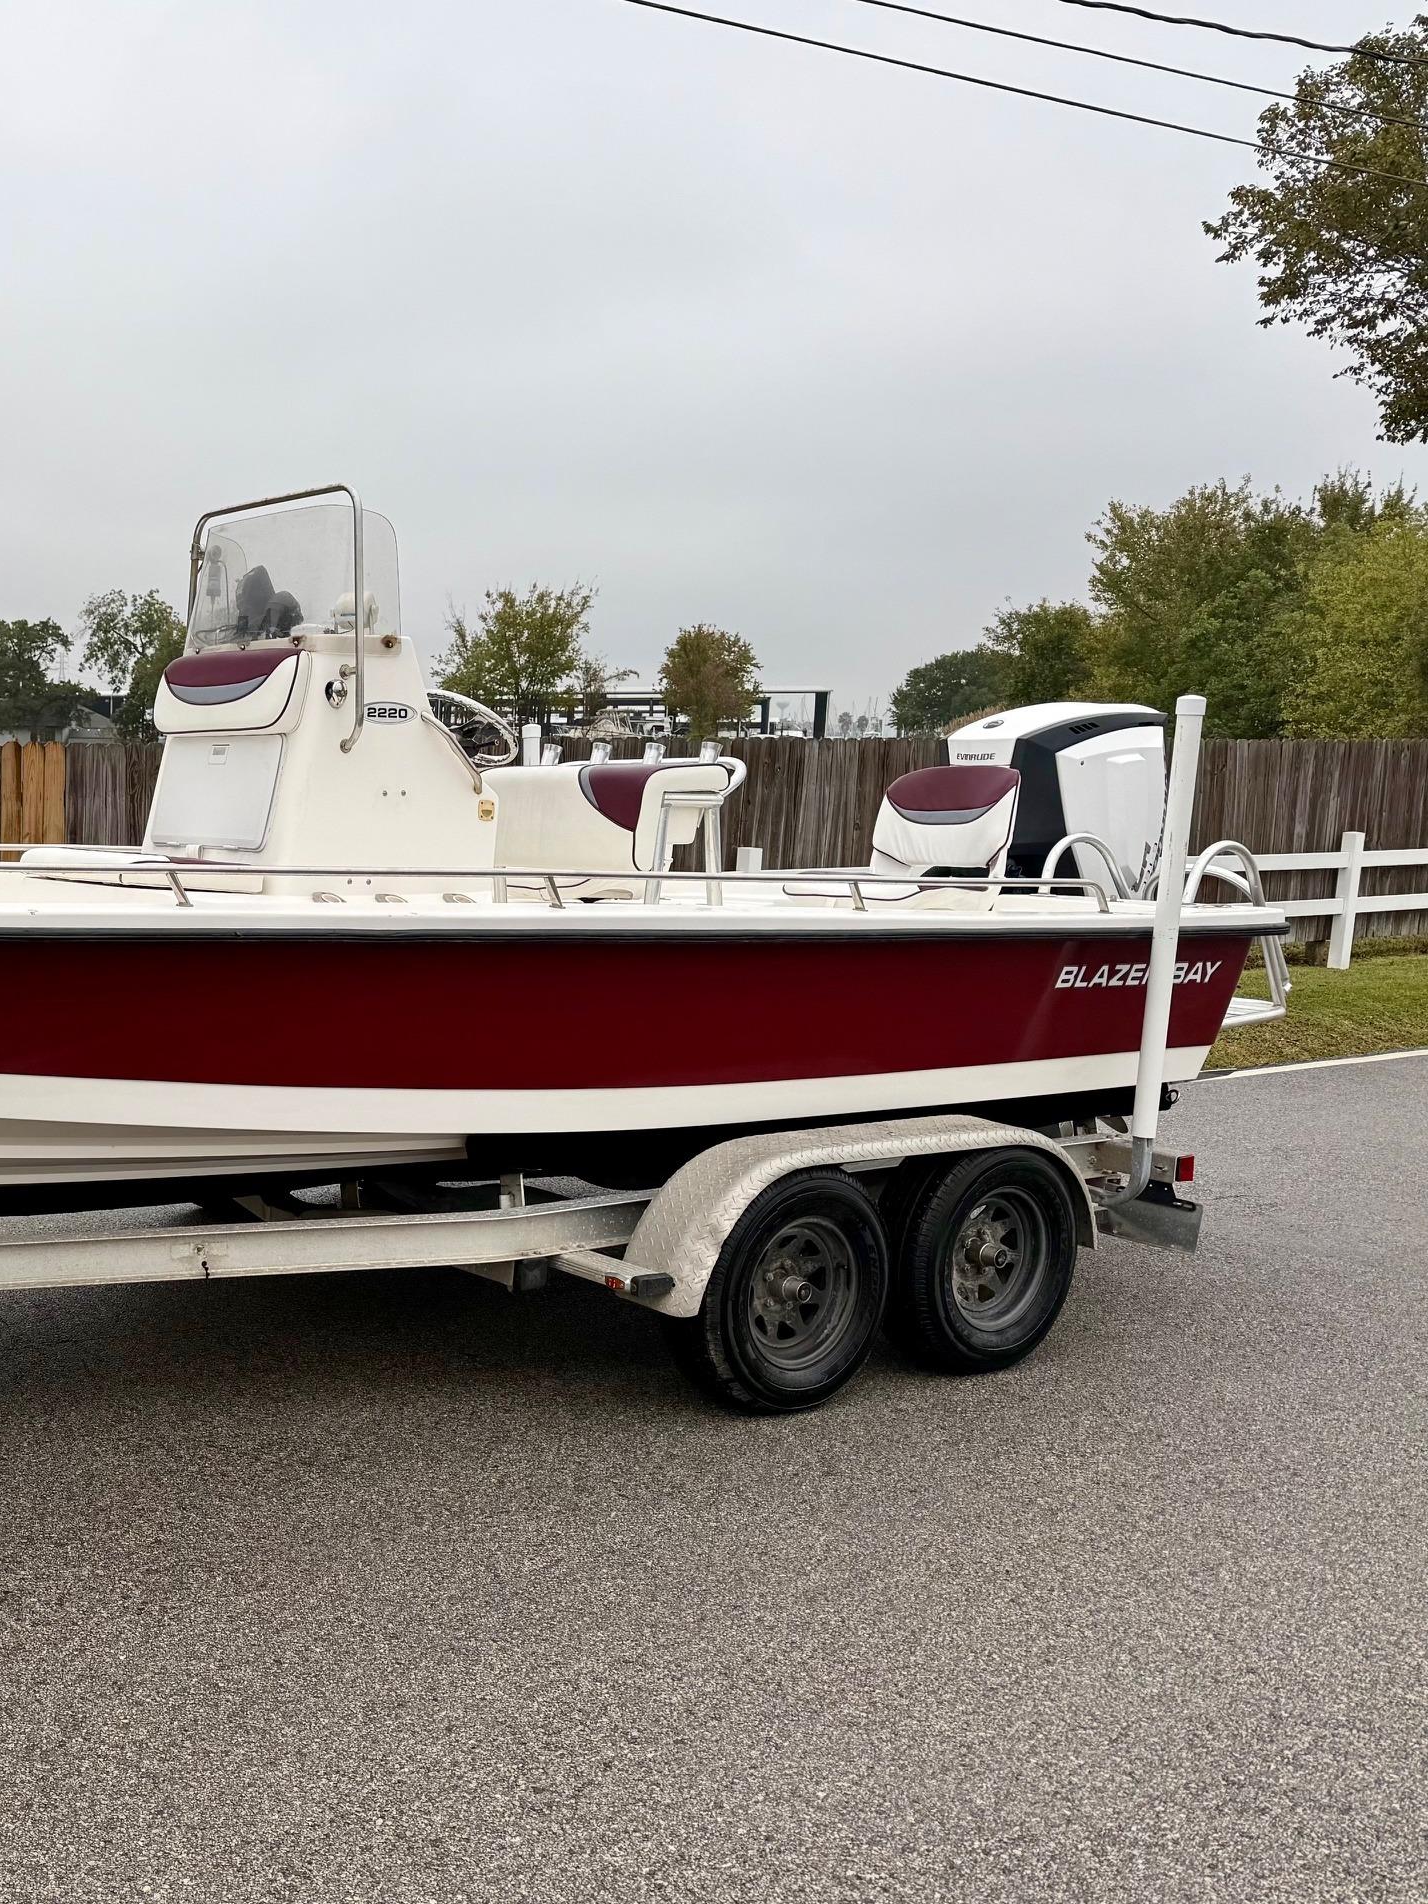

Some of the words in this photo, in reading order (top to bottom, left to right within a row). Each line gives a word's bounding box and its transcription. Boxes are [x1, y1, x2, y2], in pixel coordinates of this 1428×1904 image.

[367, 707, 408, 719] 2220
[956, 752, 996, 761] EVINRUDE
[1172, 960, 1222, 985] BAY
